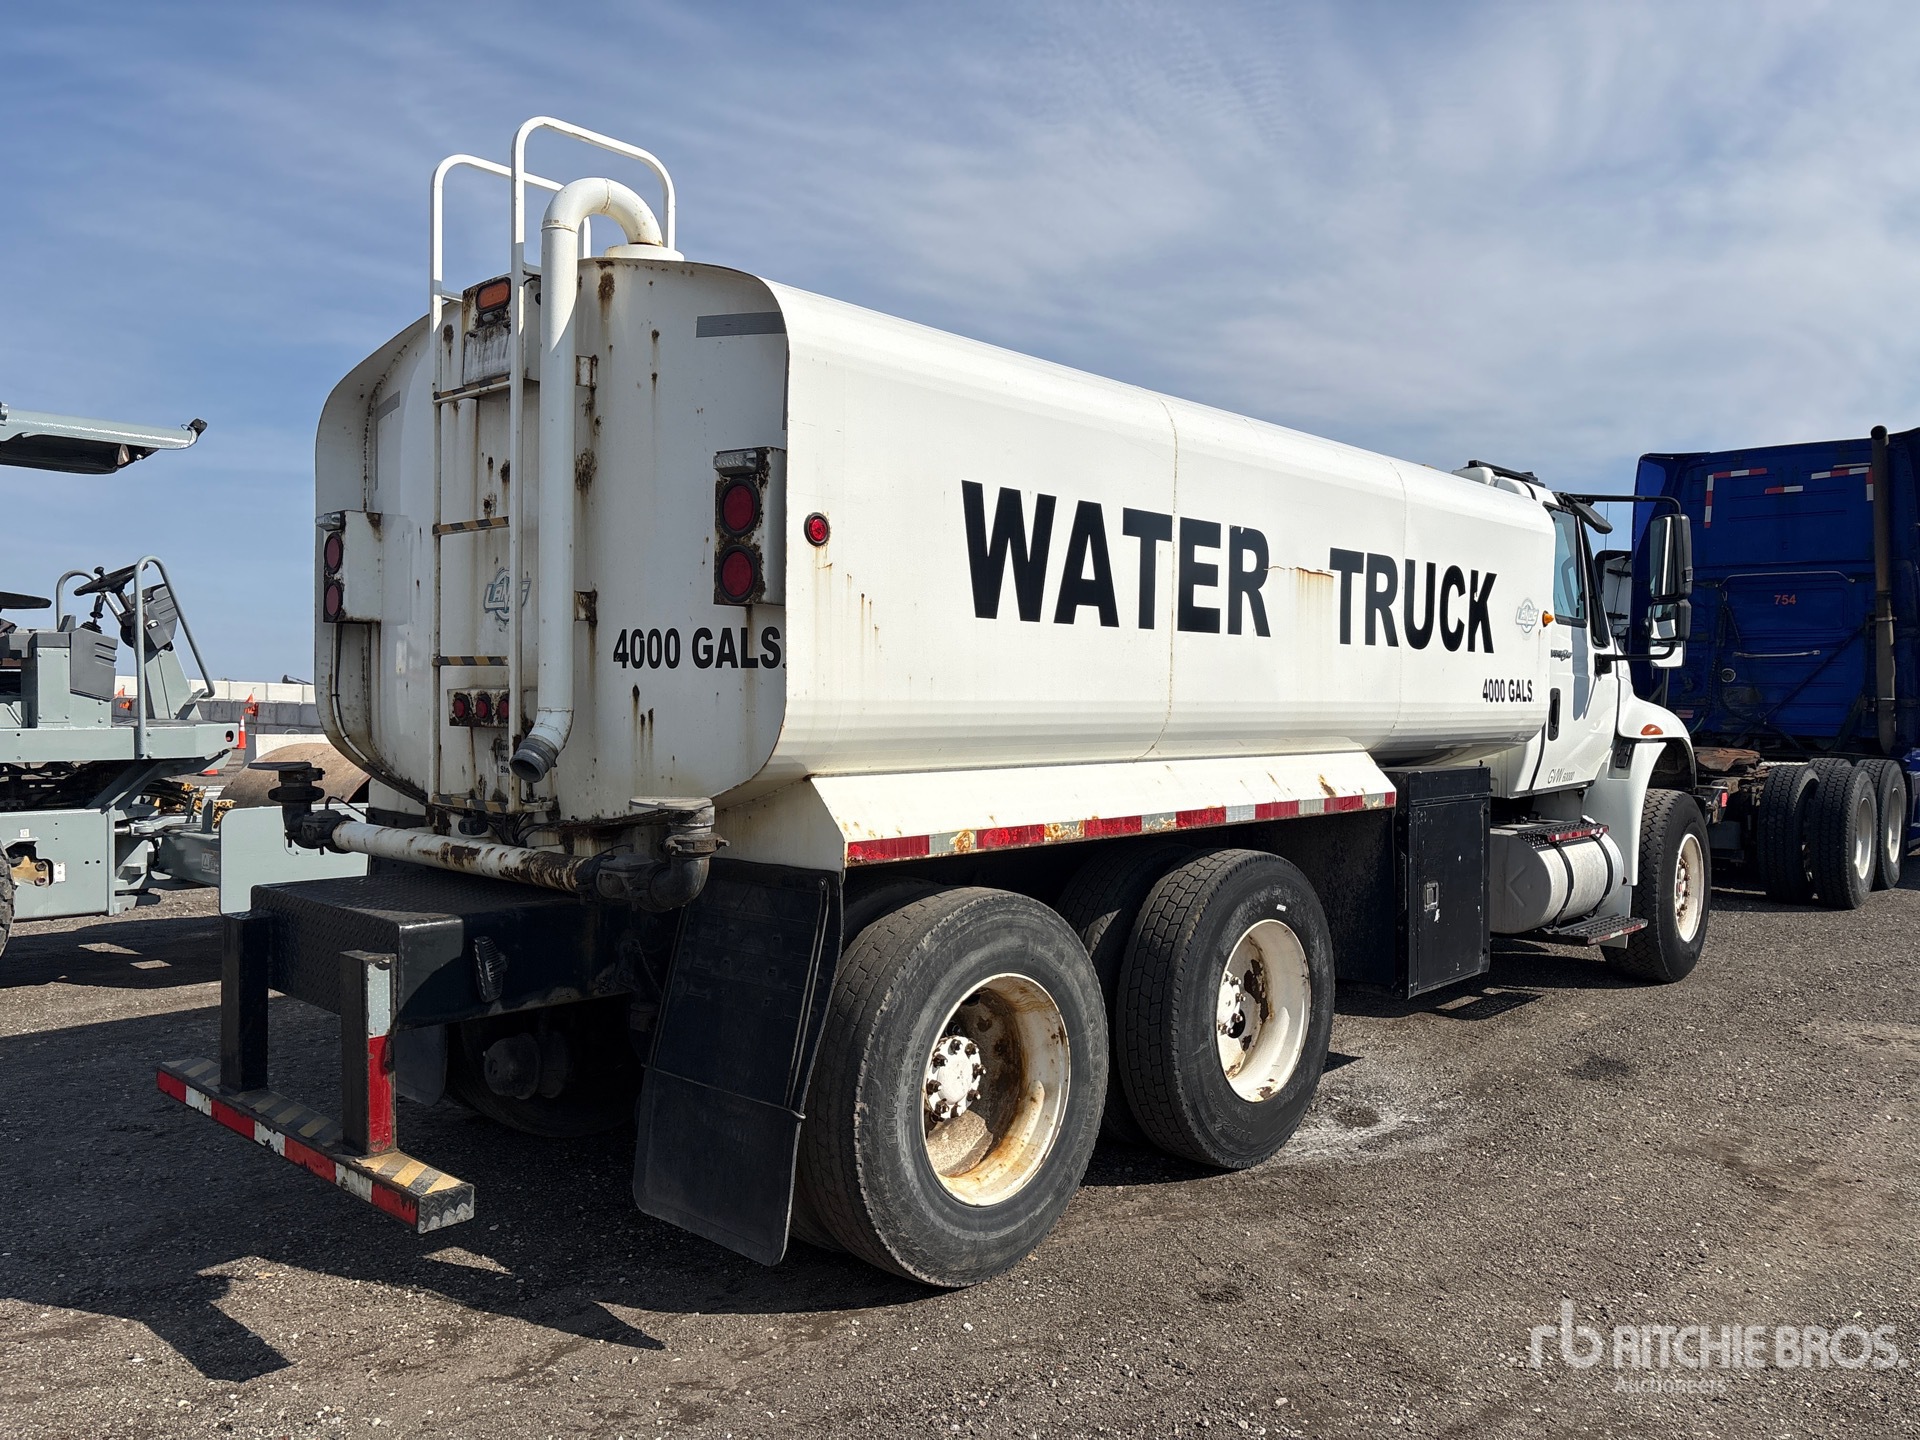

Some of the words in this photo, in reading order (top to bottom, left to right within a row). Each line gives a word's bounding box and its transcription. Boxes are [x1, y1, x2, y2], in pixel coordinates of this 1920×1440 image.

[961, 480, 1270, 638] WATER
[1330, 547, 1497, 654] TRUCK
[1774, 594, 1797, 605] 754
[613, 628, 681, 669] 4000
[691, 626, 787, 669] GALS.
[1482, 678, 1505, 702] 4000
[1508, 678, 1534, 702] GALS.
[1547, 767, 1565, 784] GVW
